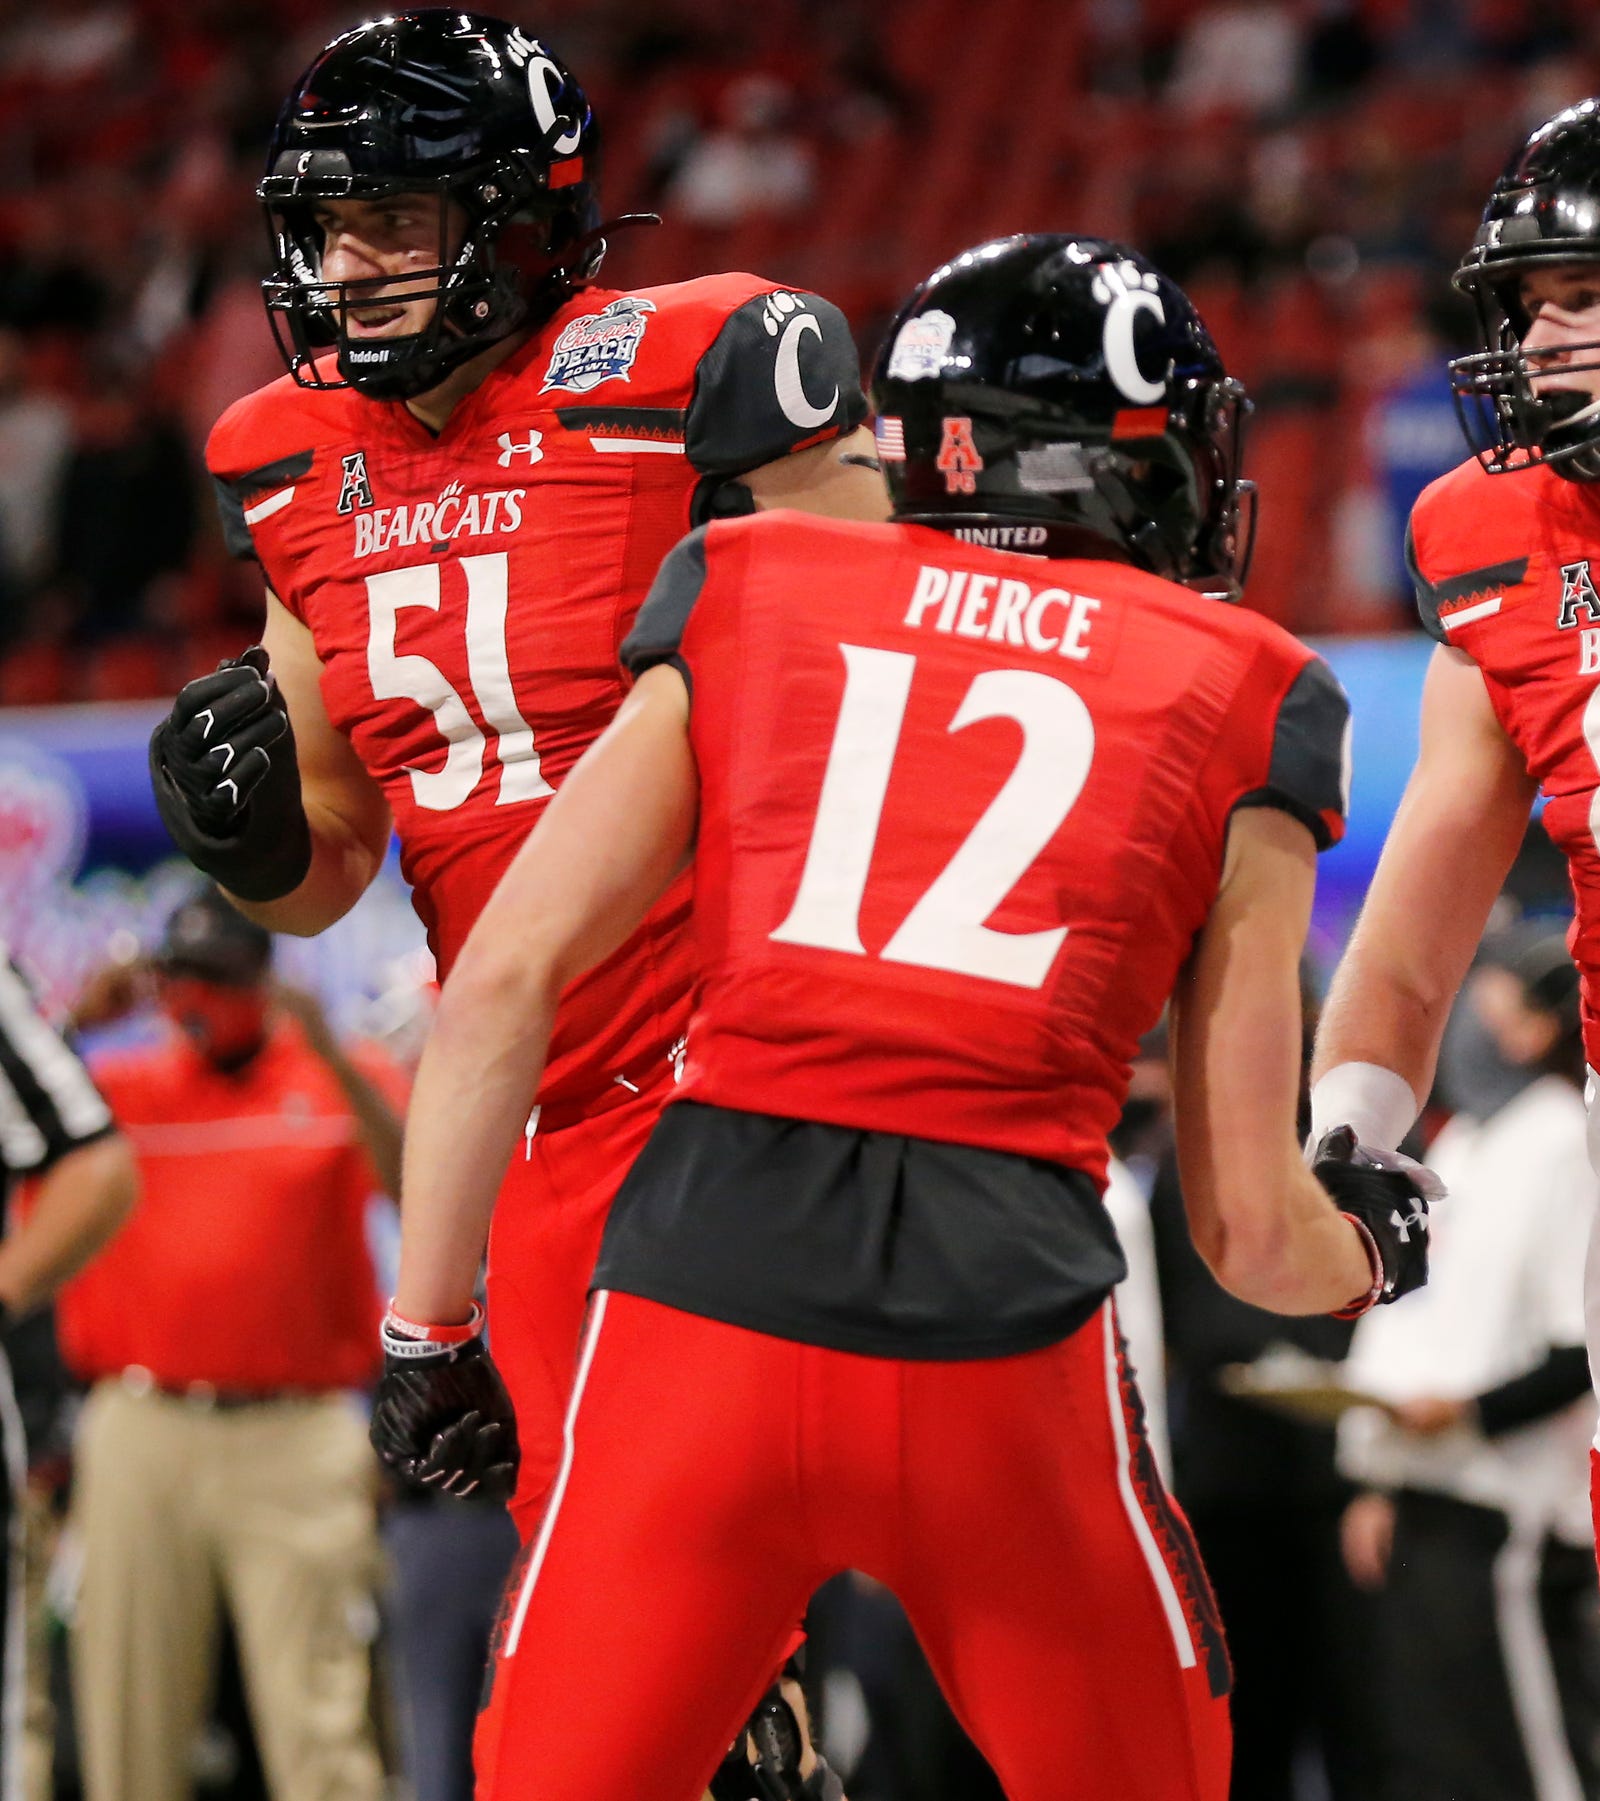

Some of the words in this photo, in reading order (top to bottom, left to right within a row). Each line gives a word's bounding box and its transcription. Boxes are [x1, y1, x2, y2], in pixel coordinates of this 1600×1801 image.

[297, 152, 312, 174] C
[349, 351, 389, 363] Riddell
[551, 338, 636, 375] PEACH
[562, 362, 612, 380] BOWL
[774, 313, 839, 429] C
[1103, 289, 1168, 405] C
[936, 417, 983, 470] A
[336, 450, 375, 516] A
[353, 481, 527, 559] BEARCATS
[954, 527, 1049, 547] UNITED
[904, 565, 1101, 660] PIERCE
[365, 552, 558, 811] 51
[768, 642, 1096, 989] 12
